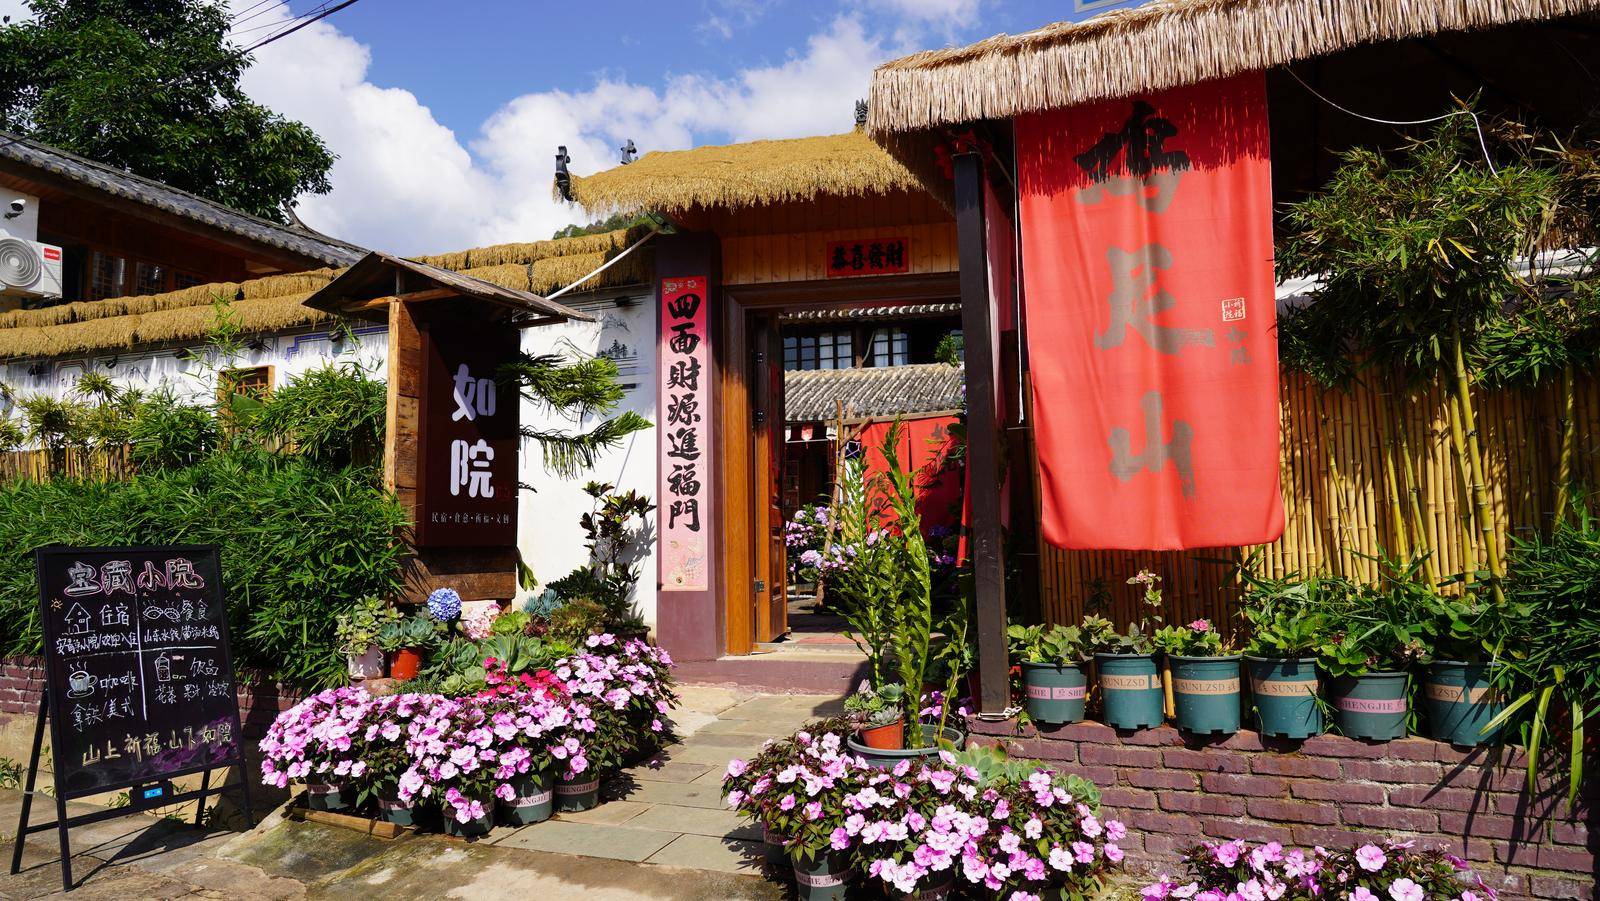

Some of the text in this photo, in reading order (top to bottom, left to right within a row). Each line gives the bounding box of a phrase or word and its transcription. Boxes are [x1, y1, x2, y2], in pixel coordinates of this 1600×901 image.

[451, 363, 497, 498] 如院
[667, 293, 702, 532] 四面財源進福門
[64, 558, 204, 597] 宝藏小院
[99, 603, 130, 626] 住宿
[99, 671, 138, 697] 咖啡
[189, 657, 219, 678] 饮品
[70, 696, 135, 732] 拿铁/美式
